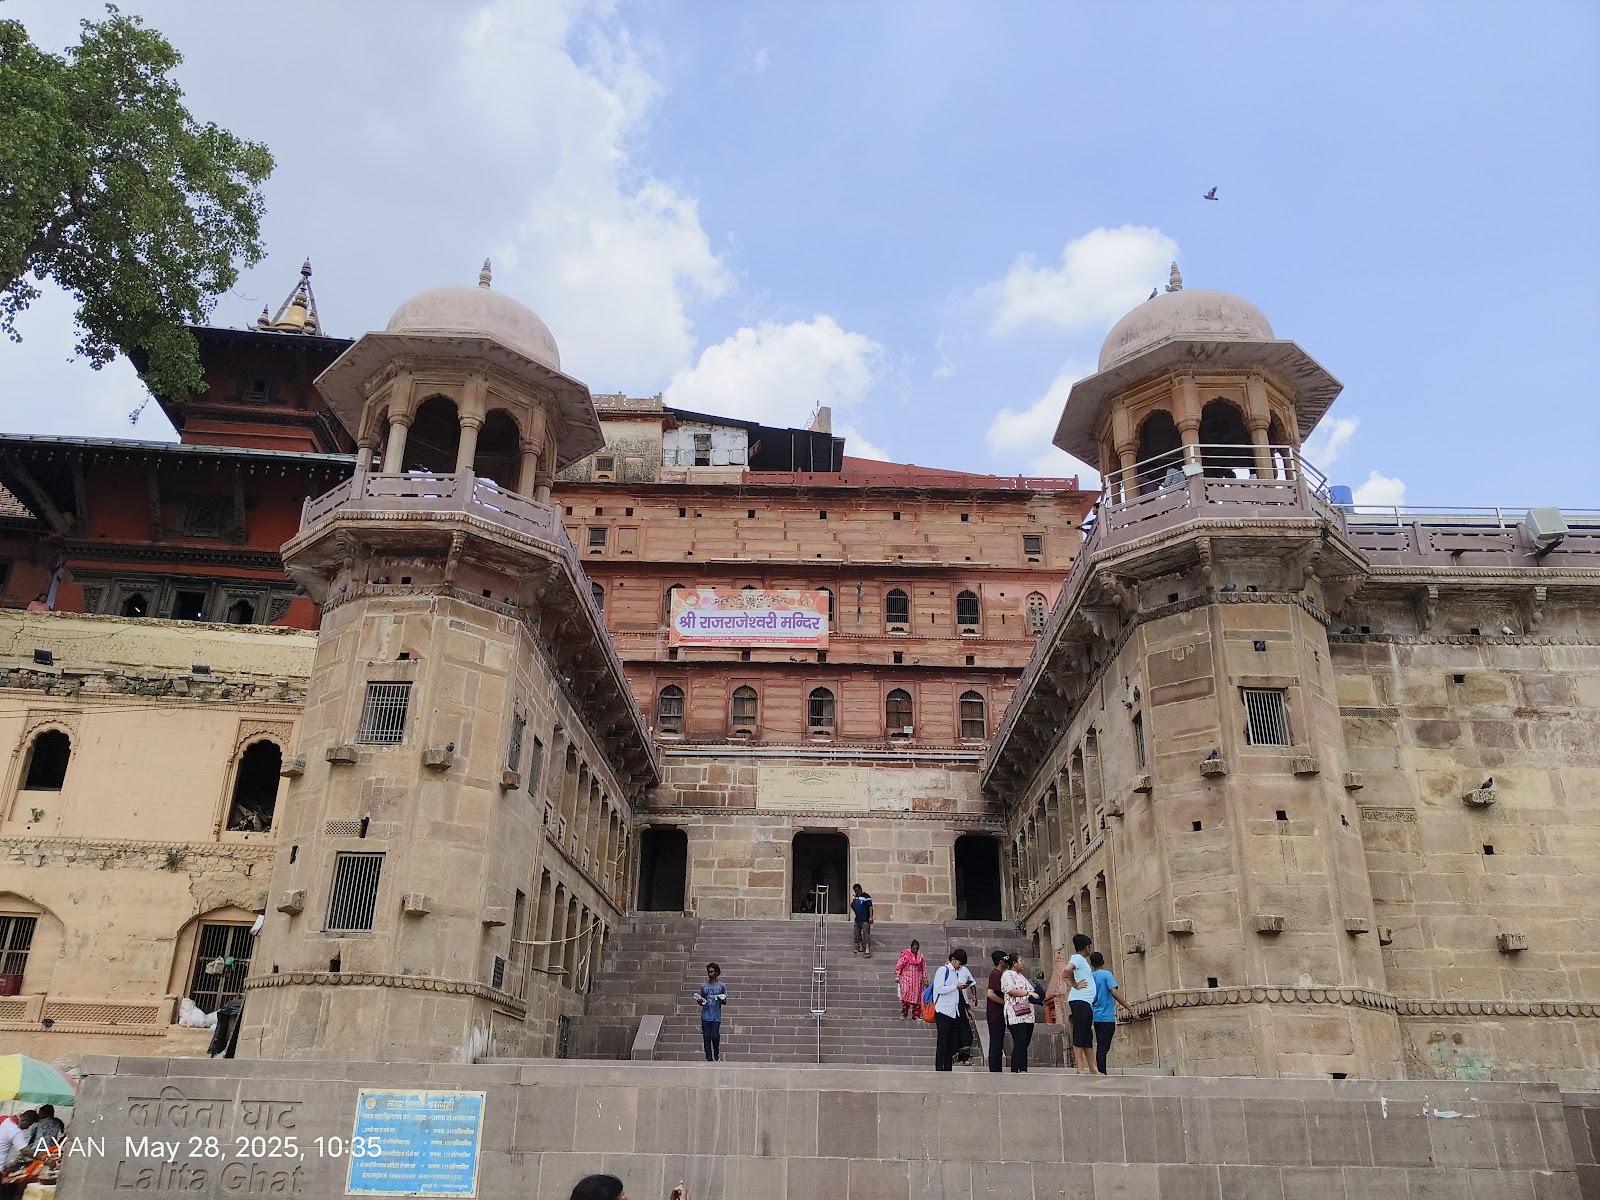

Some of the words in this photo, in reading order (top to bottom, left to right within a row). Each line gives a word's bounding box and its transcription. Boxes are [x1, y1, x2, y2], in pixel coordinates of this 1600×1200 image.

[679, 611, 696, 629] श्री
[699, 611, 778, 629] राजराजेश्वरी
[780, 612, 821, 629] मन्दिर
[128, 1086, 233, 1129] ललिता
[241, 1100, 303, 1130] घाट
[114, 1161, 209, 1193] Lalita
[220, 1162, 305, 1196] Ghat
